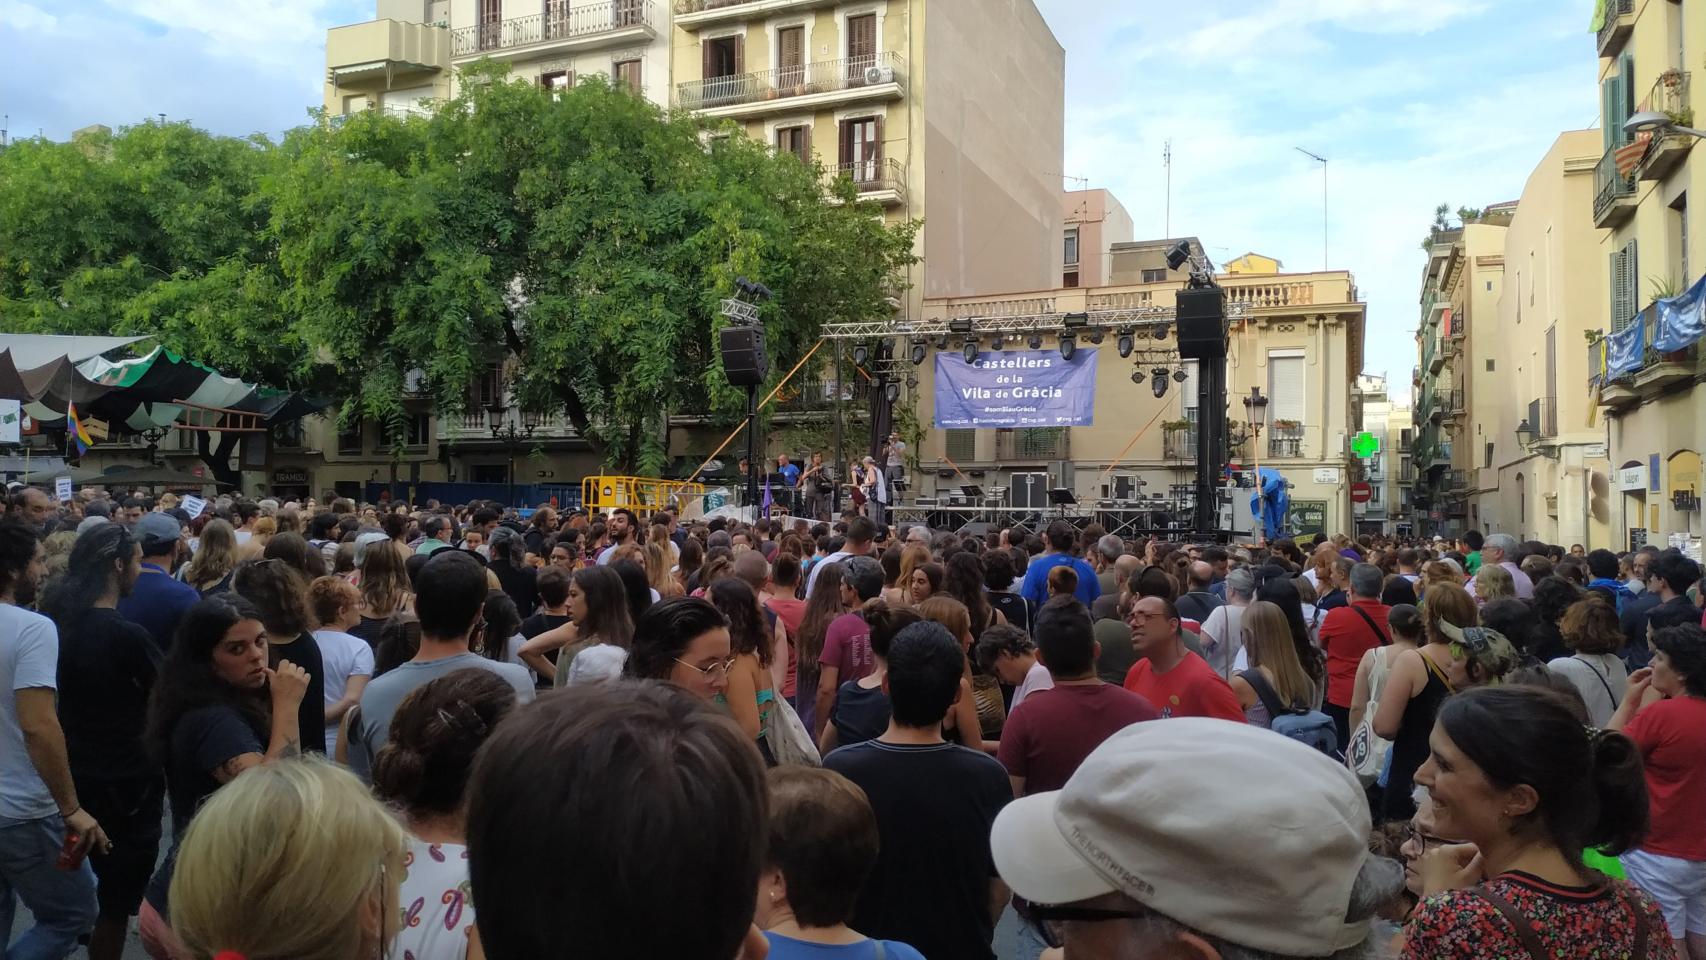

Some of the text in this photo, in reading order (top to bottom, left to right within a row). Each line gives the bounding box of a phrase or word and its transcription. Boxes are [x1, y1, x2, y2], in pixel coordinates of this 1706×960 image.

[972, 356, 1051, 369] Castellers
[996, 374, 1023, 384] de la
[962, 385, 1062, 399] Vila de Gràcia
